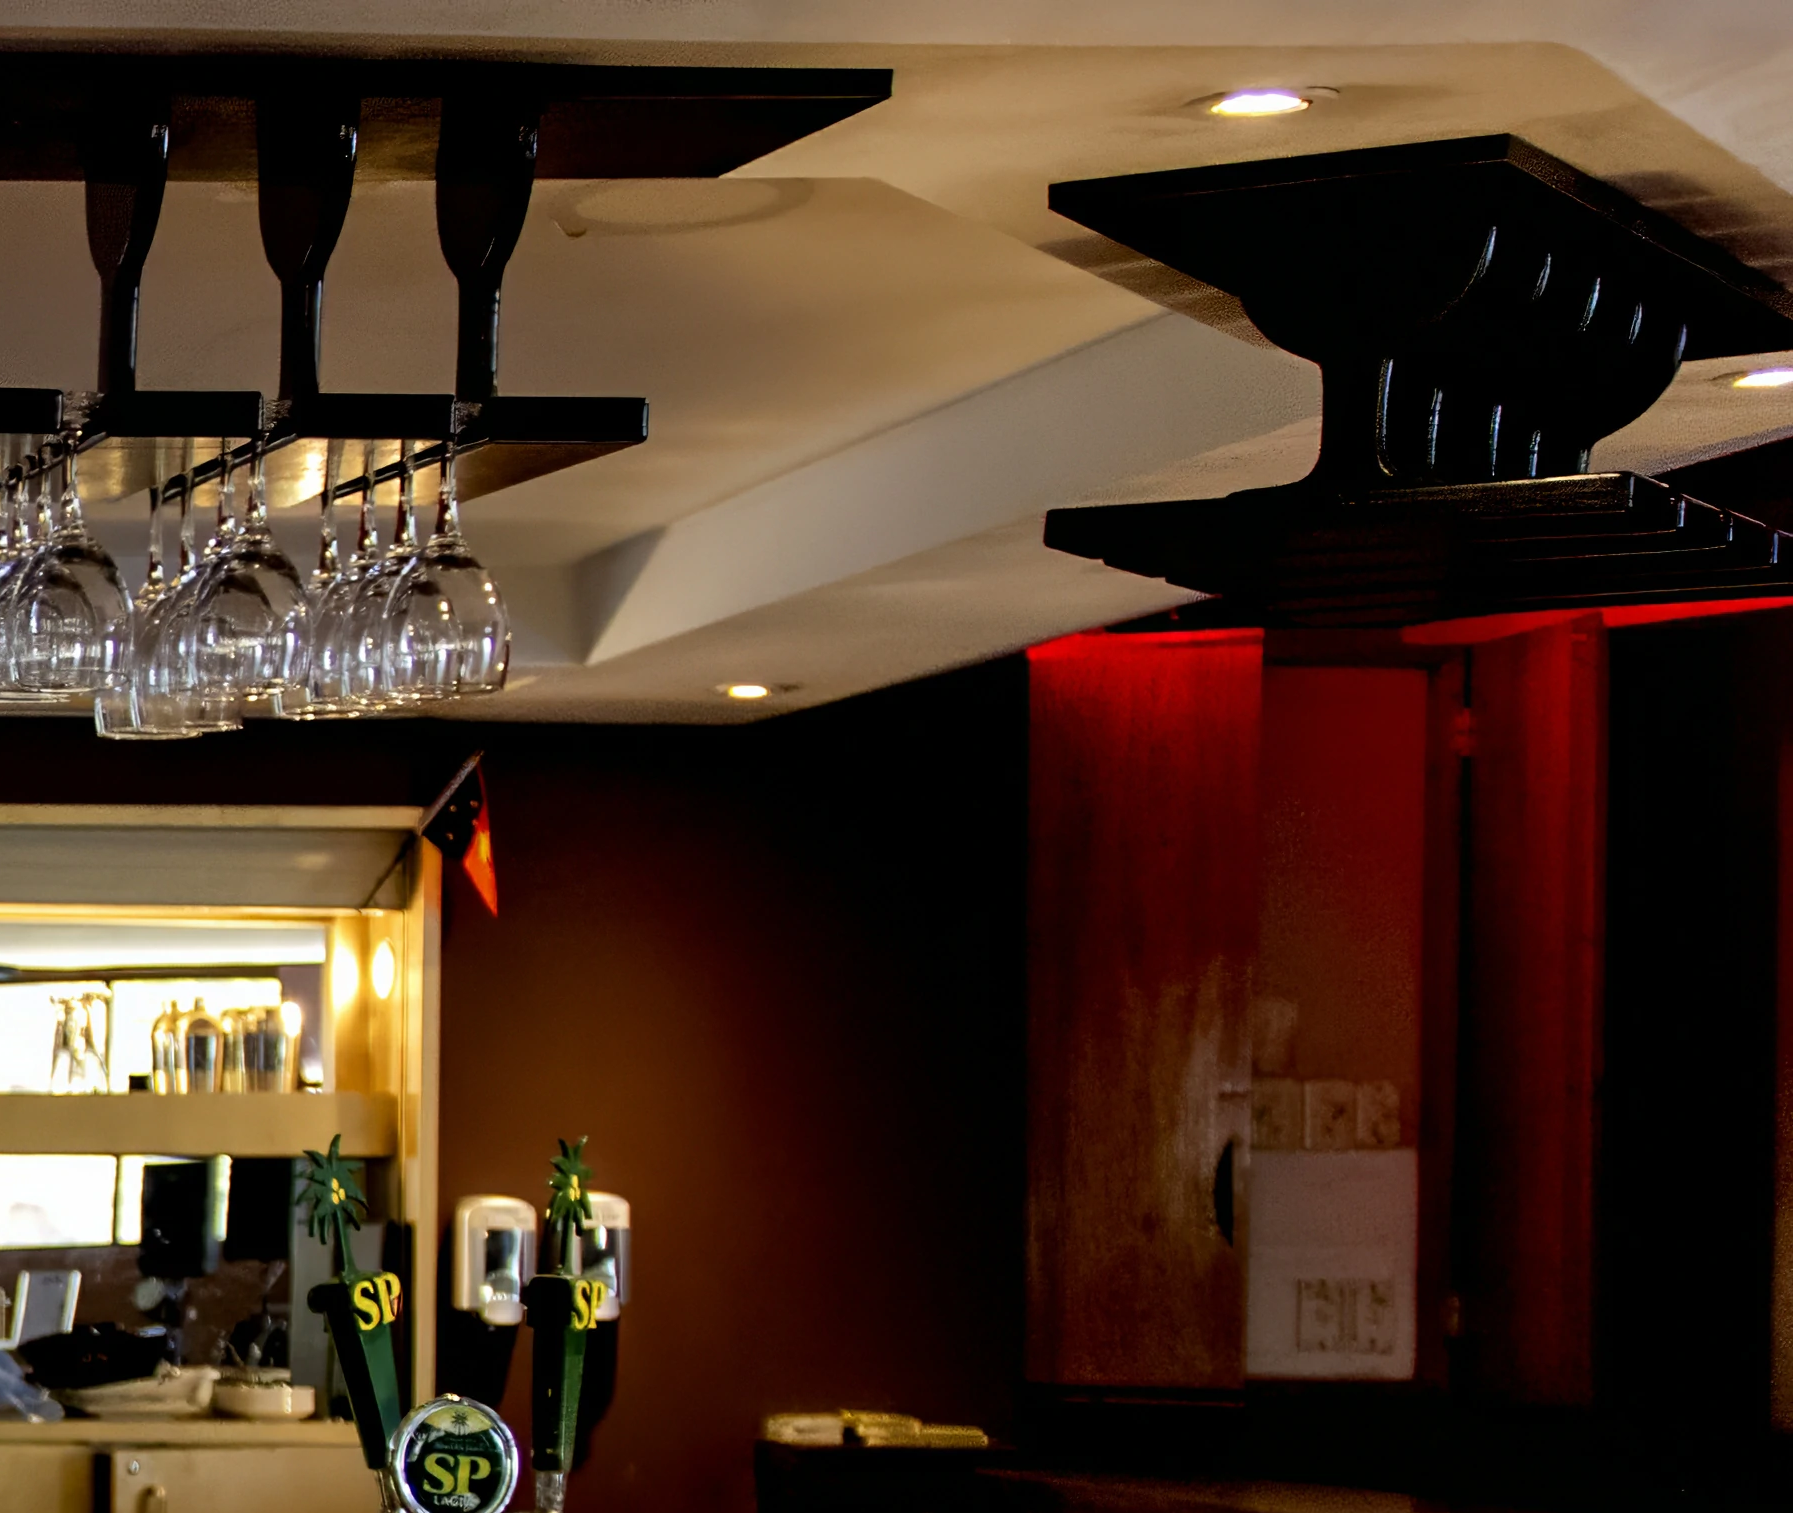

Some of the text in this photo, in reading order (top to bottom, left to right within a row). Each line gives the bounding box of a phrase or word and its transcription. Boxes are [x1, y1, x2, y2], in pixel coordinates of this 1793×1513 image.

[353, 1272, 401, 1331] SP
[571, 1280, 607, 1330] SP
[423, 1453, 491, 1494] SP
